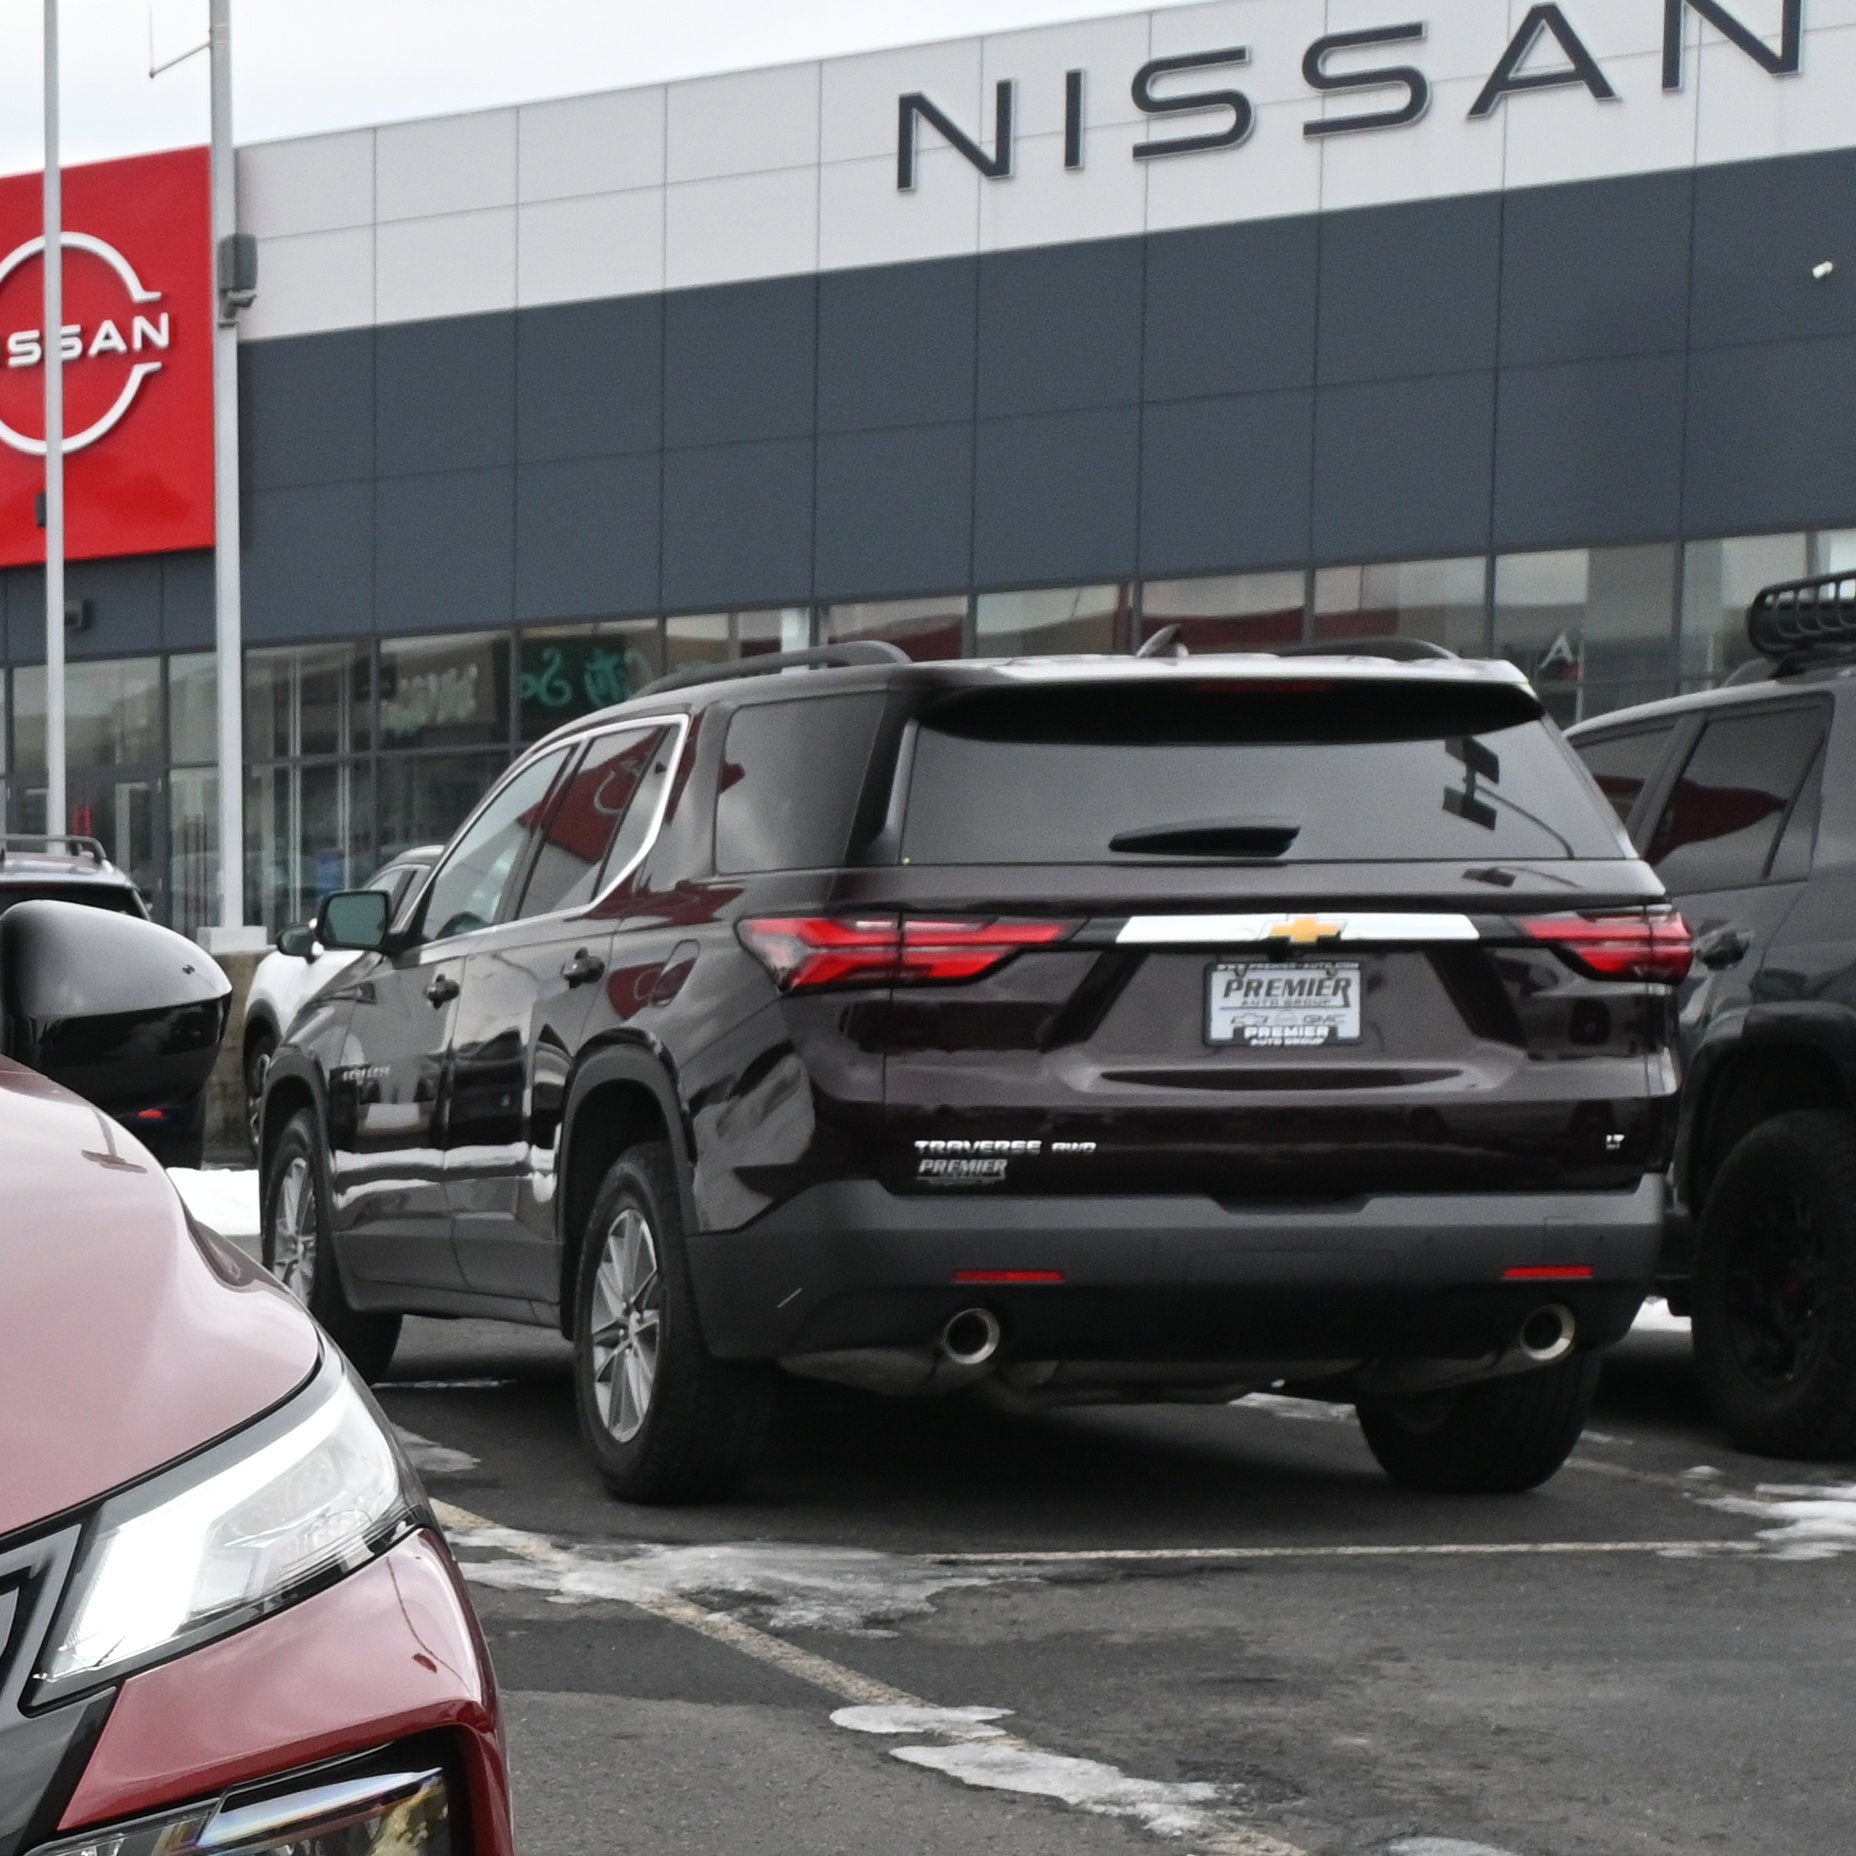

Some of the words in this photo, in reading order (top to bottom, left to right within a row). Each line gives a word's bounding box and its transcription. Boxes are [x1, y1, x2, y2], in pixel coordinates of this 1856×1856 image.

[896, 0, 1805, 192] NISSAN
[1223, 977, 1351, 1003] PREMIER
[1244, 1026, 1329, 1038] PREMIER
[914, 1140, 1042, 1154] TRAVERSE
[918, 1158, 1008, 1174] PREMIER
